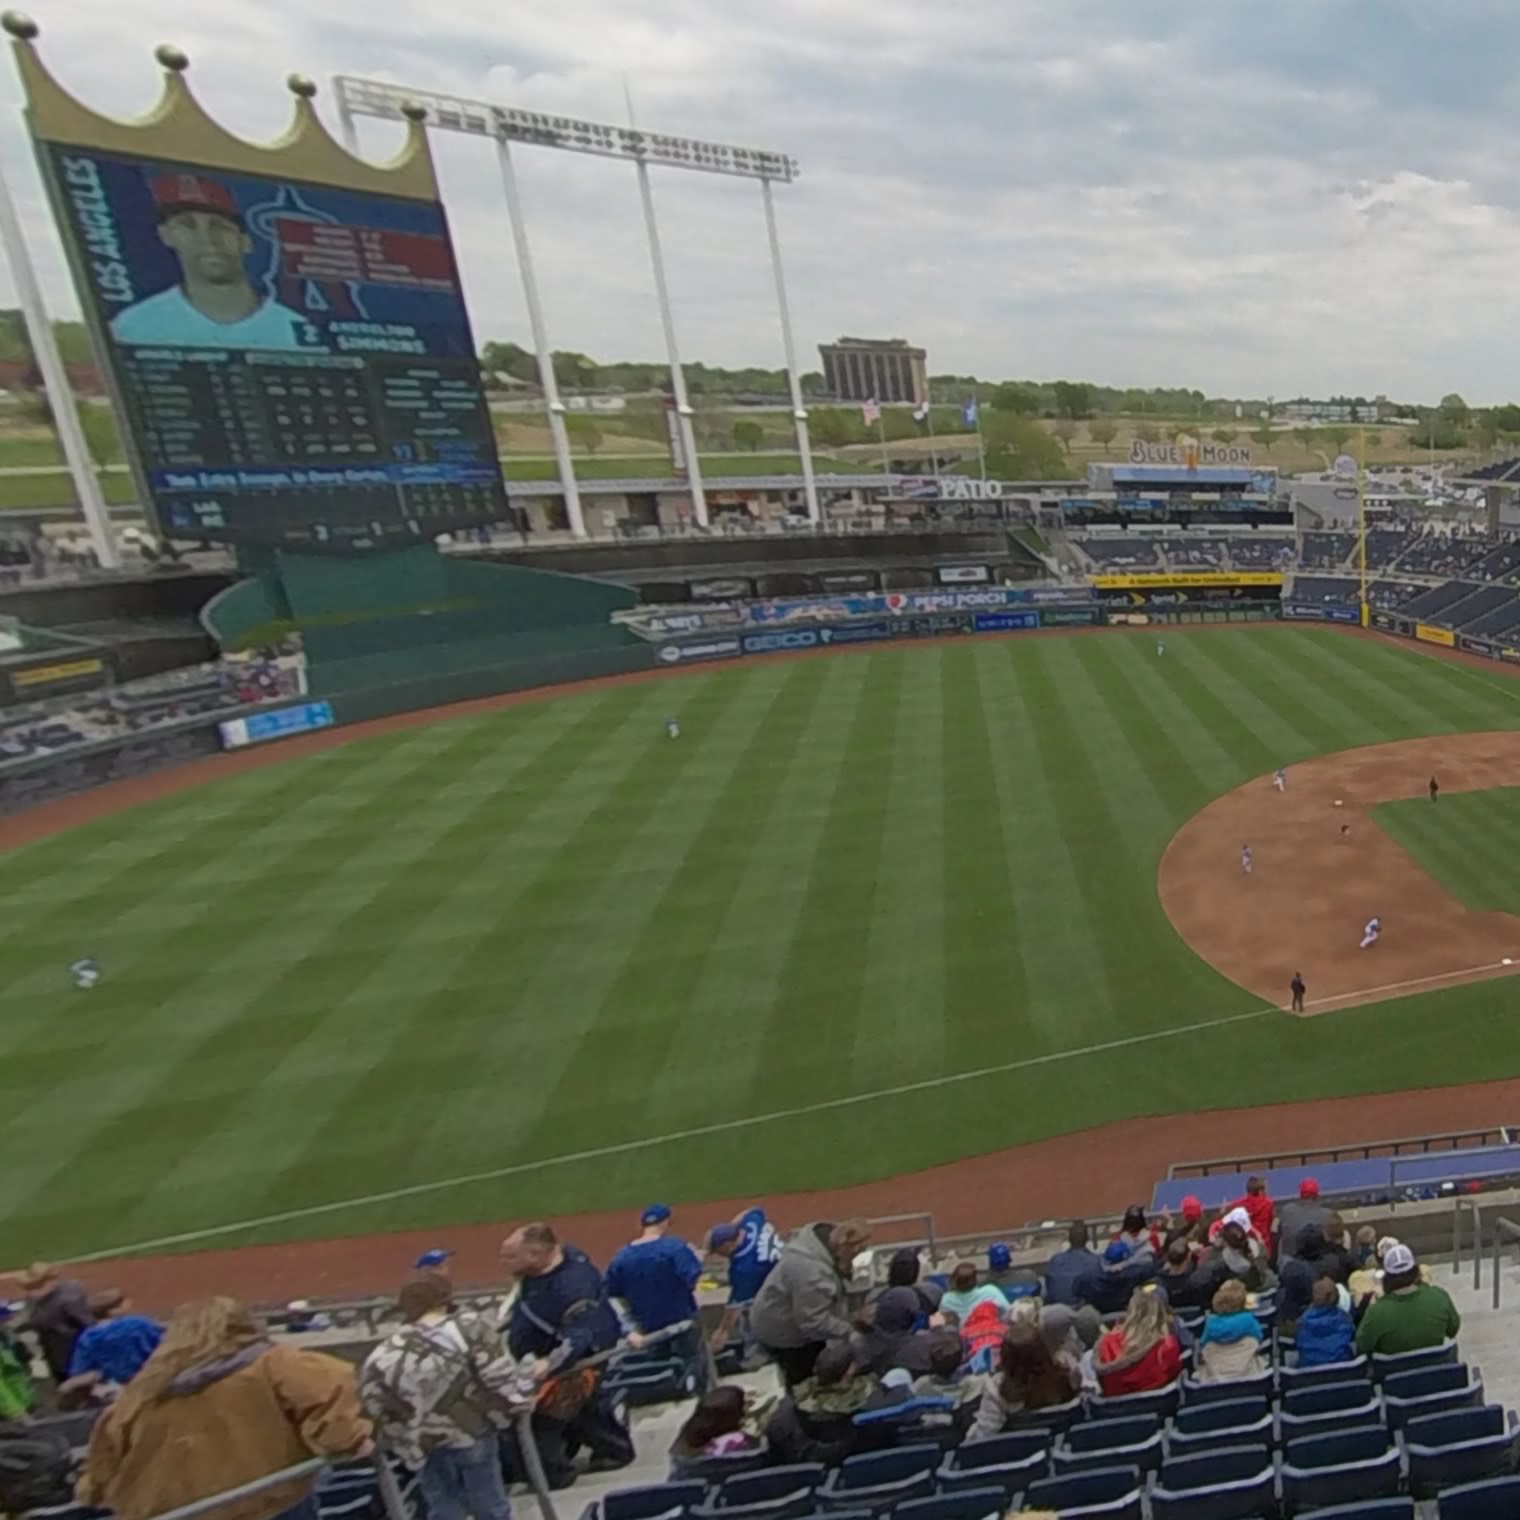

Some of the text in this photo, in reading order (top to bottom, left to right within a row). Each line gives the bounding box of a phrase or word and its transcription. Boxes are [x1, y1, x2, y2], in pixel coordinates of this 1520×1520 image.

[61, 156, 134, 302] LOS ANGELES
[1129, 439, 1251, 464] BLUE MOON
[941, 480, 1002, 499] PATIO
[914, 592, 1007, 609] PEPSI PORCH
[744, 630, 817, 651] GEICO
